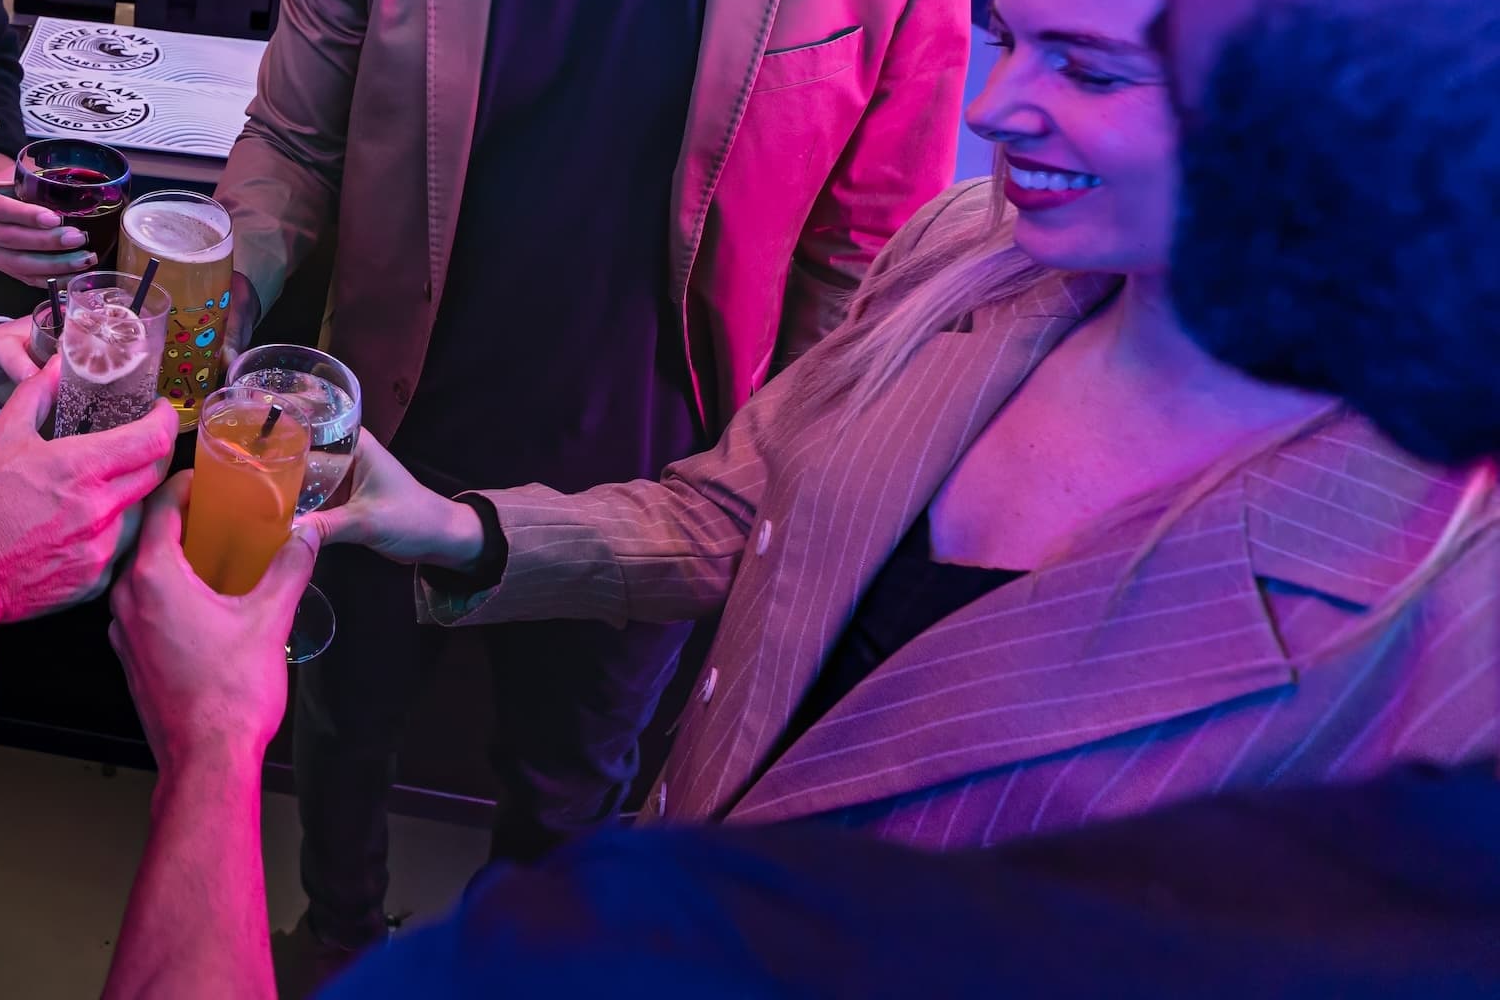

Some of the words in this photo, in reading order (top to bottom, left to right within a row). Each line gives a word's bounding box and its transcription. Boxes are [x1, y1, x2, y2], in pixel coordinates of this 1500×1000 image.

[48, 28, 91, 50] WHITE
[96, 28, 154, 46] CLAW
[64, 55, 101, 68] HARD
[25, 81, 73, 106] WHITE
[78, 81, 143, 101] CLAW
[41, 112, 83, 128] HARD
